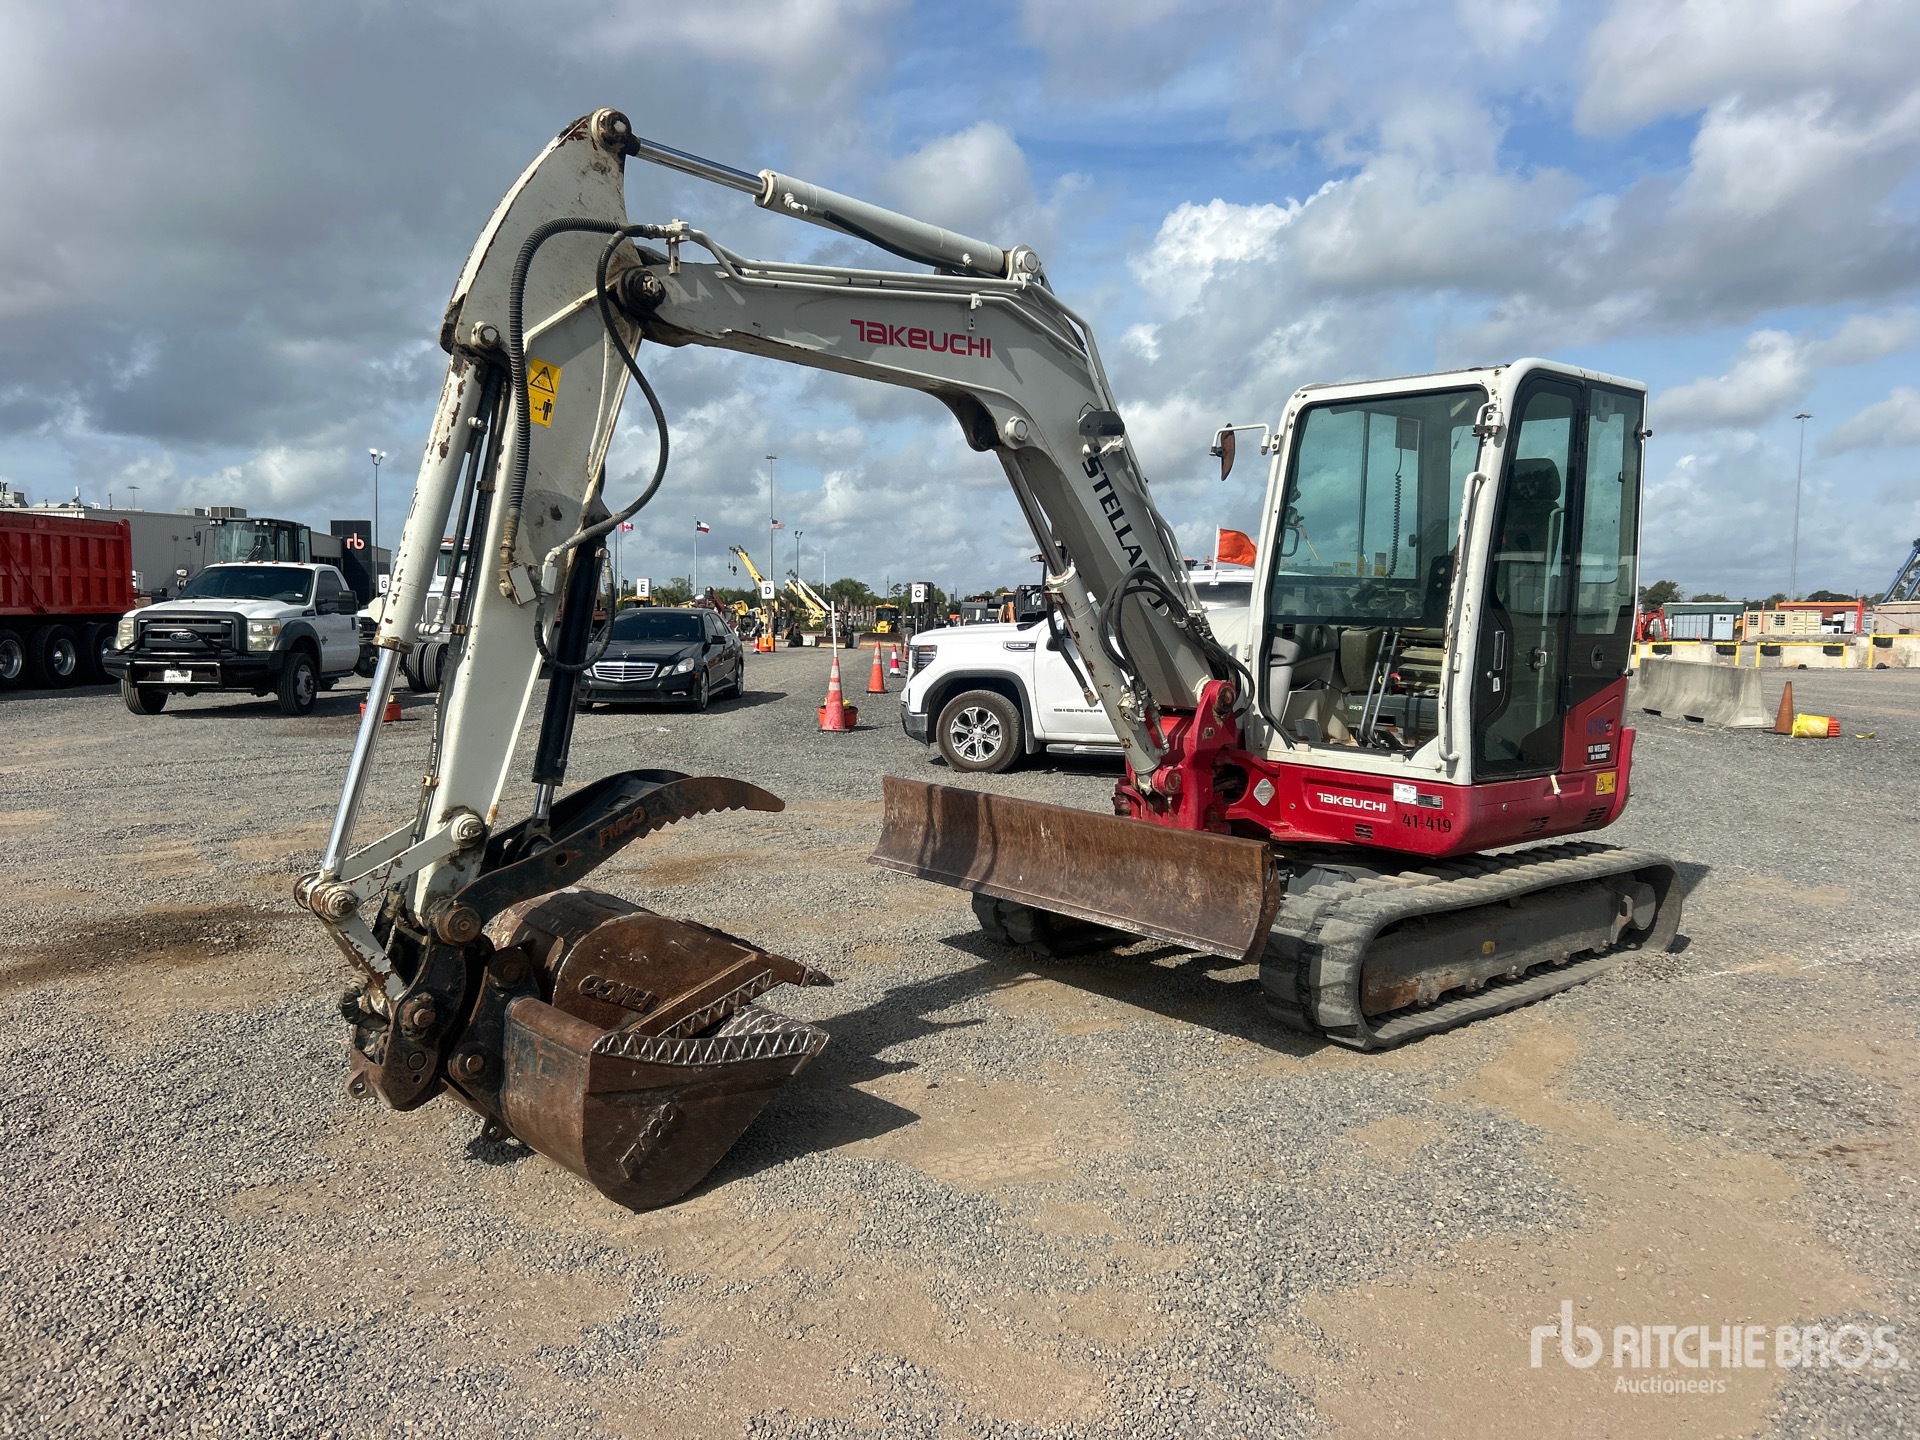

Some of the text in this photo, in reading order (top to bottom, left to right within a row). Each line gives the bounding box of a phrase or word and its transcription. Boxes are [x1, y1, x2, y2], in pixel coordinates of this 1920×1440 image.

[346, 532, 365, 550] rb
[380, 580, 388, 589] G
[640, 584, 646, 593] E
[764, 586, 772, 595] D
[914, 589, 922, 598] C
[1402, 813, 1452, 833] 41-419
